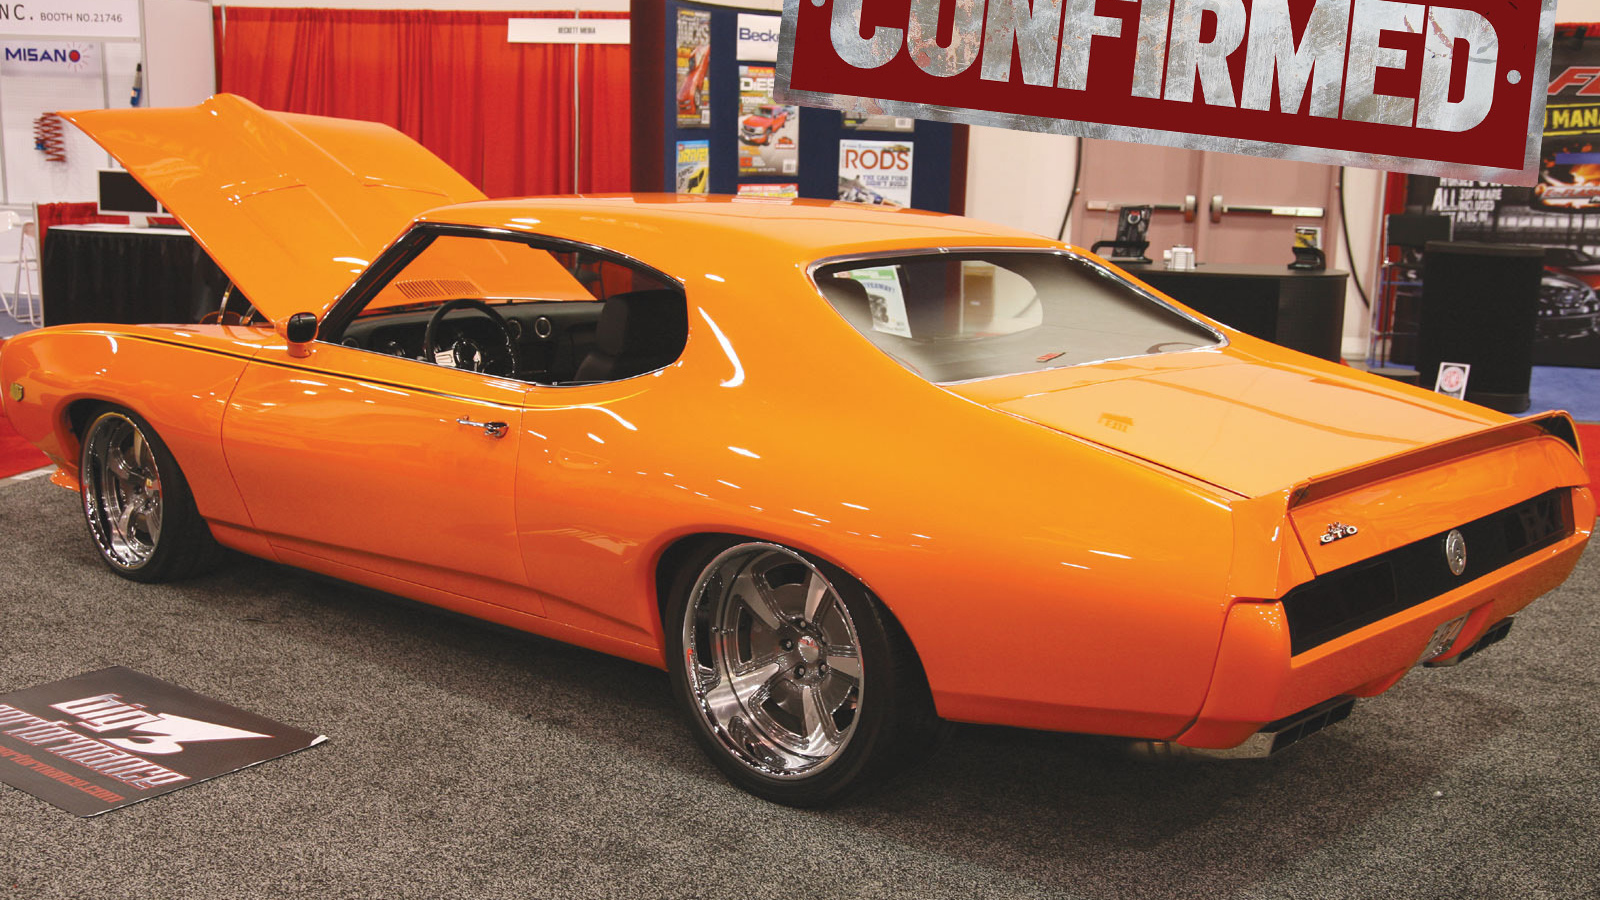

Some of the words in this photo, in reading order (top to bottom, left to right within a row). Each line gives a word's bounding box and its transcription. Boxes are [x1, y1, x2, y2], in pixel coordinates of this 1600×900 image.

[40, 12, 73, 21] BOOTH
[845, 149, 909, 171] RODS
[1431, 187, 1459, 212] ALL
[1459, 188, 1502, 201] SOFTWARE
[1458, 200, 1495, 211] INCLUDED
[1320, 526, 1358, 543] GTO
